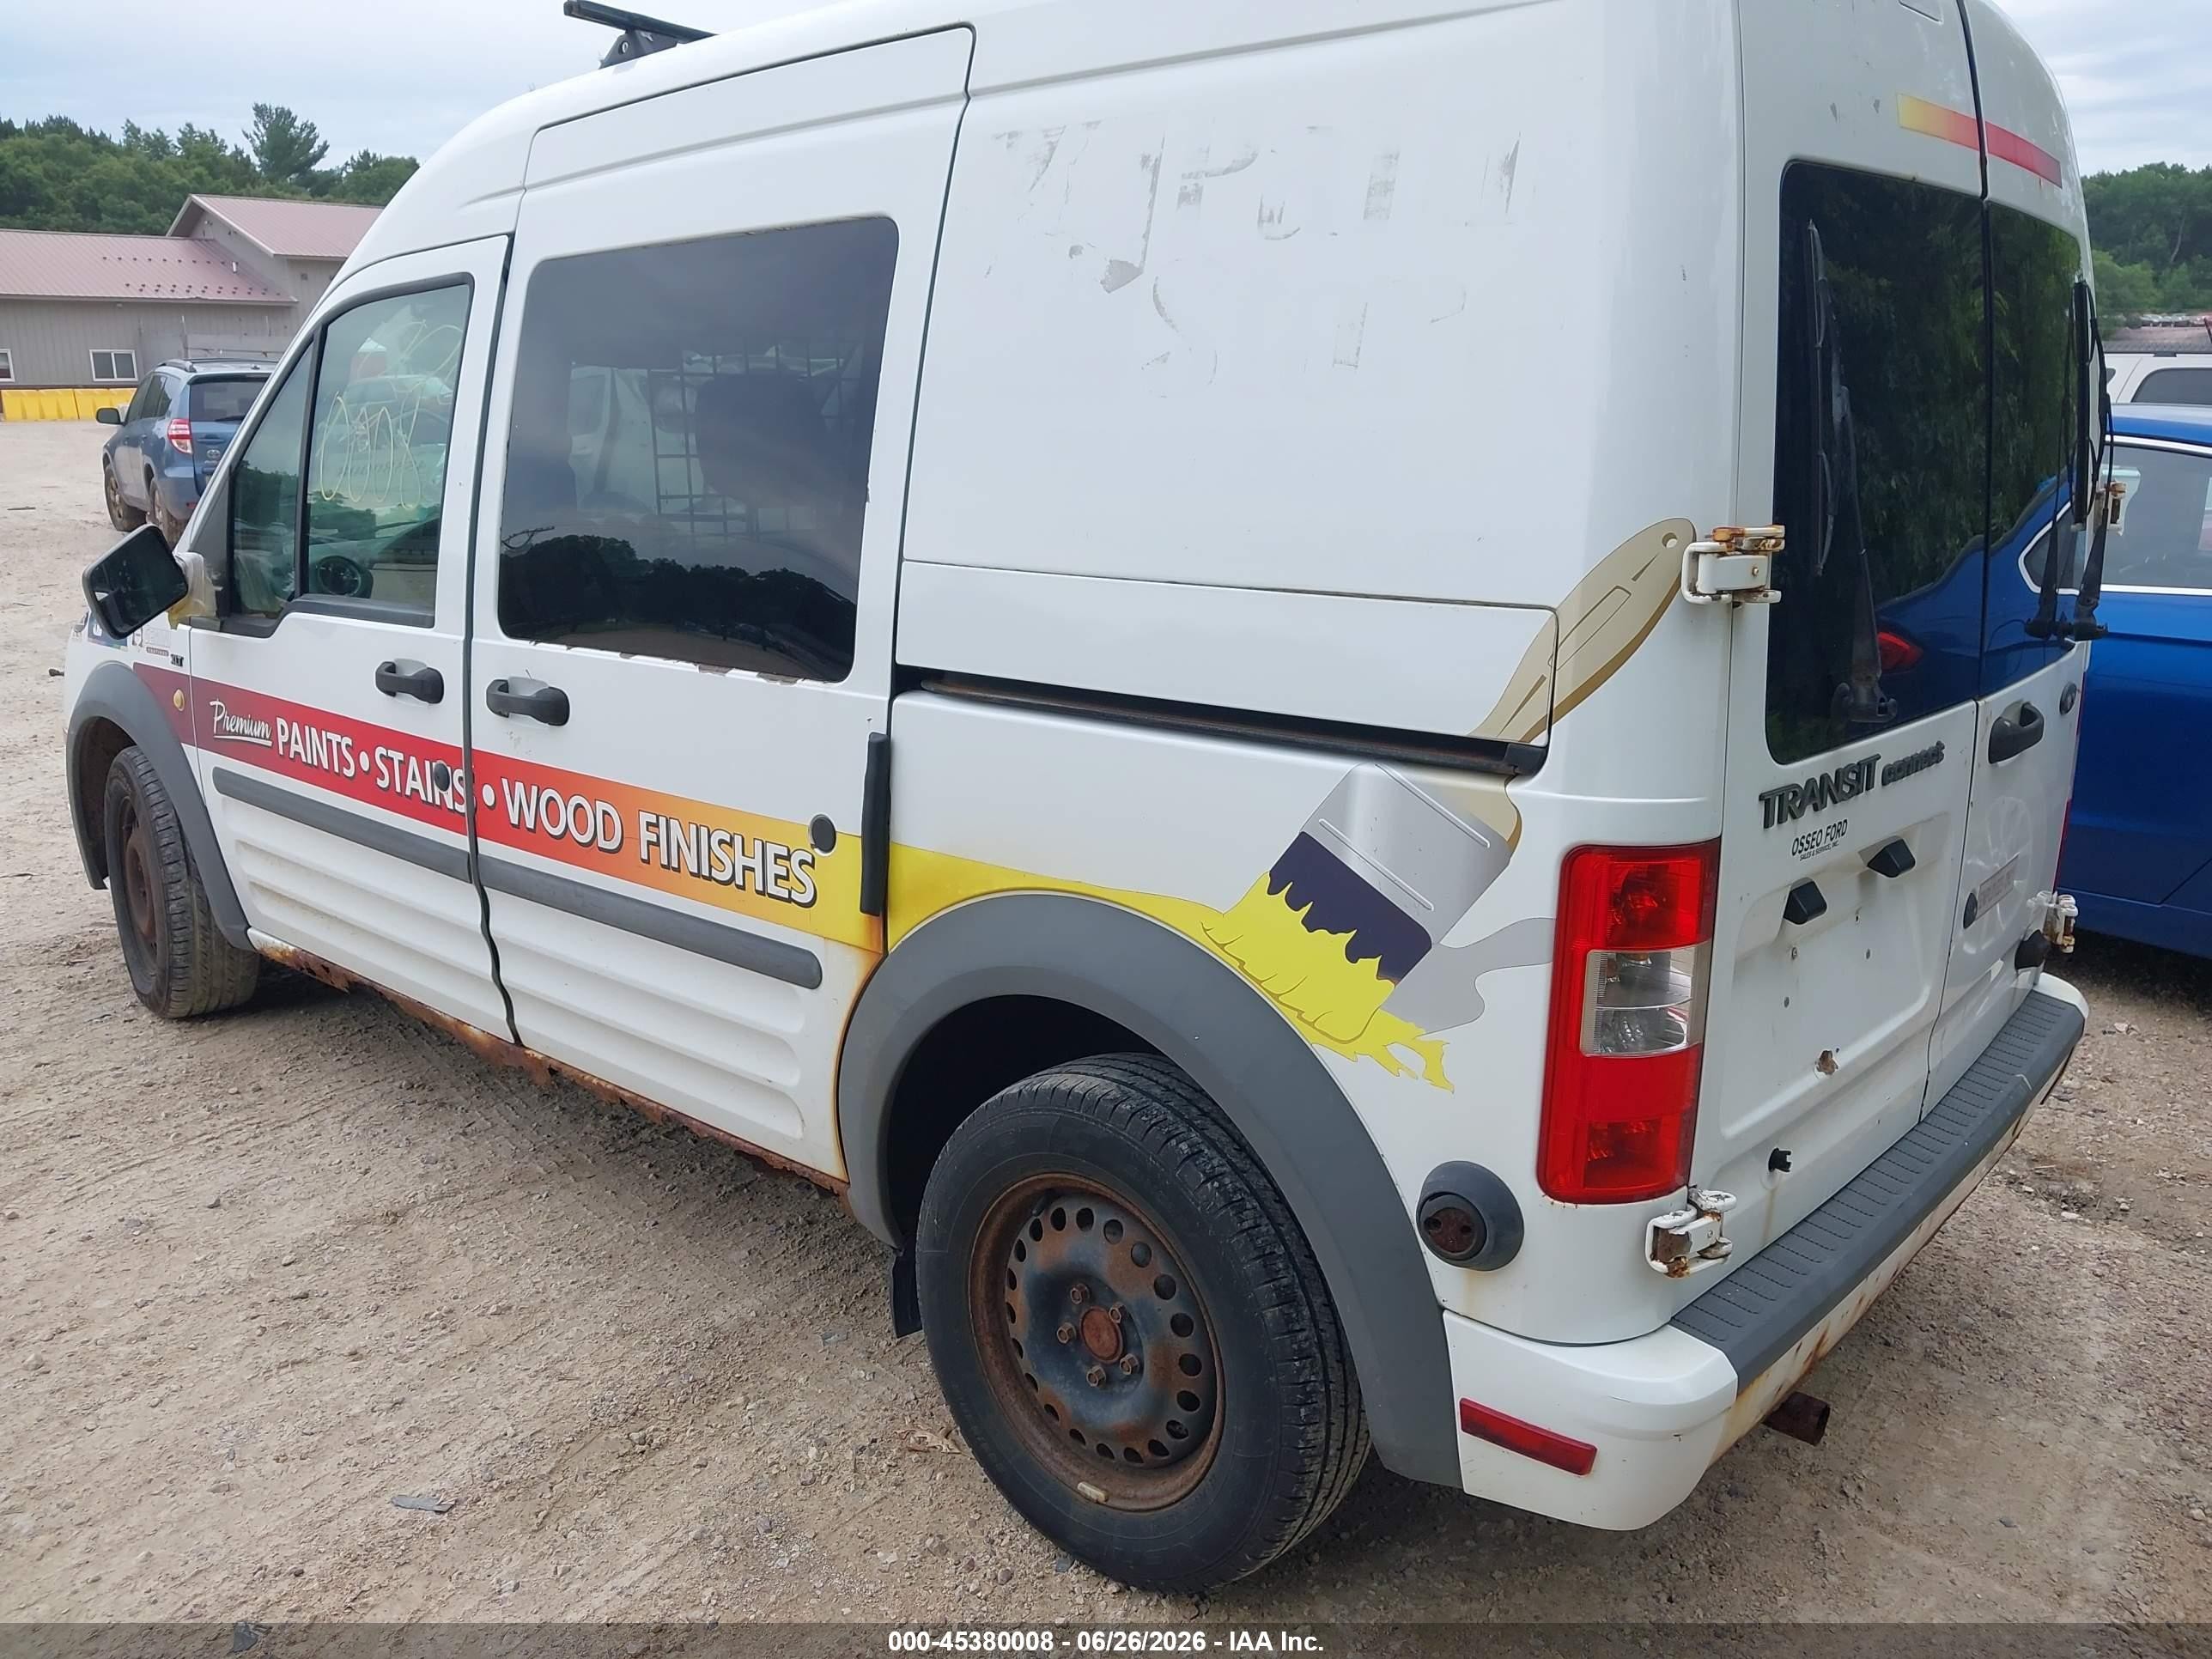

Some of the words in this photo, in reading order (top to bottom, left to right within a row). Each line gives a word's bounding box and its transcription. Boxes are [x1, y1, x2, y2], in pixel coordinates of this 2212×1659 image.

[209, 698, 272, 741] Premium
[276, 716, 356, 778] PAINTS
[501, 776, 623, 854] WOOD
[638, 810, 817, 908] FINISHES
[1759, 753, 1881, 829] TRANSIT
[1791, 828, 1823, 857] OSSEO
[1824, 818, 1848, 845] FORD
